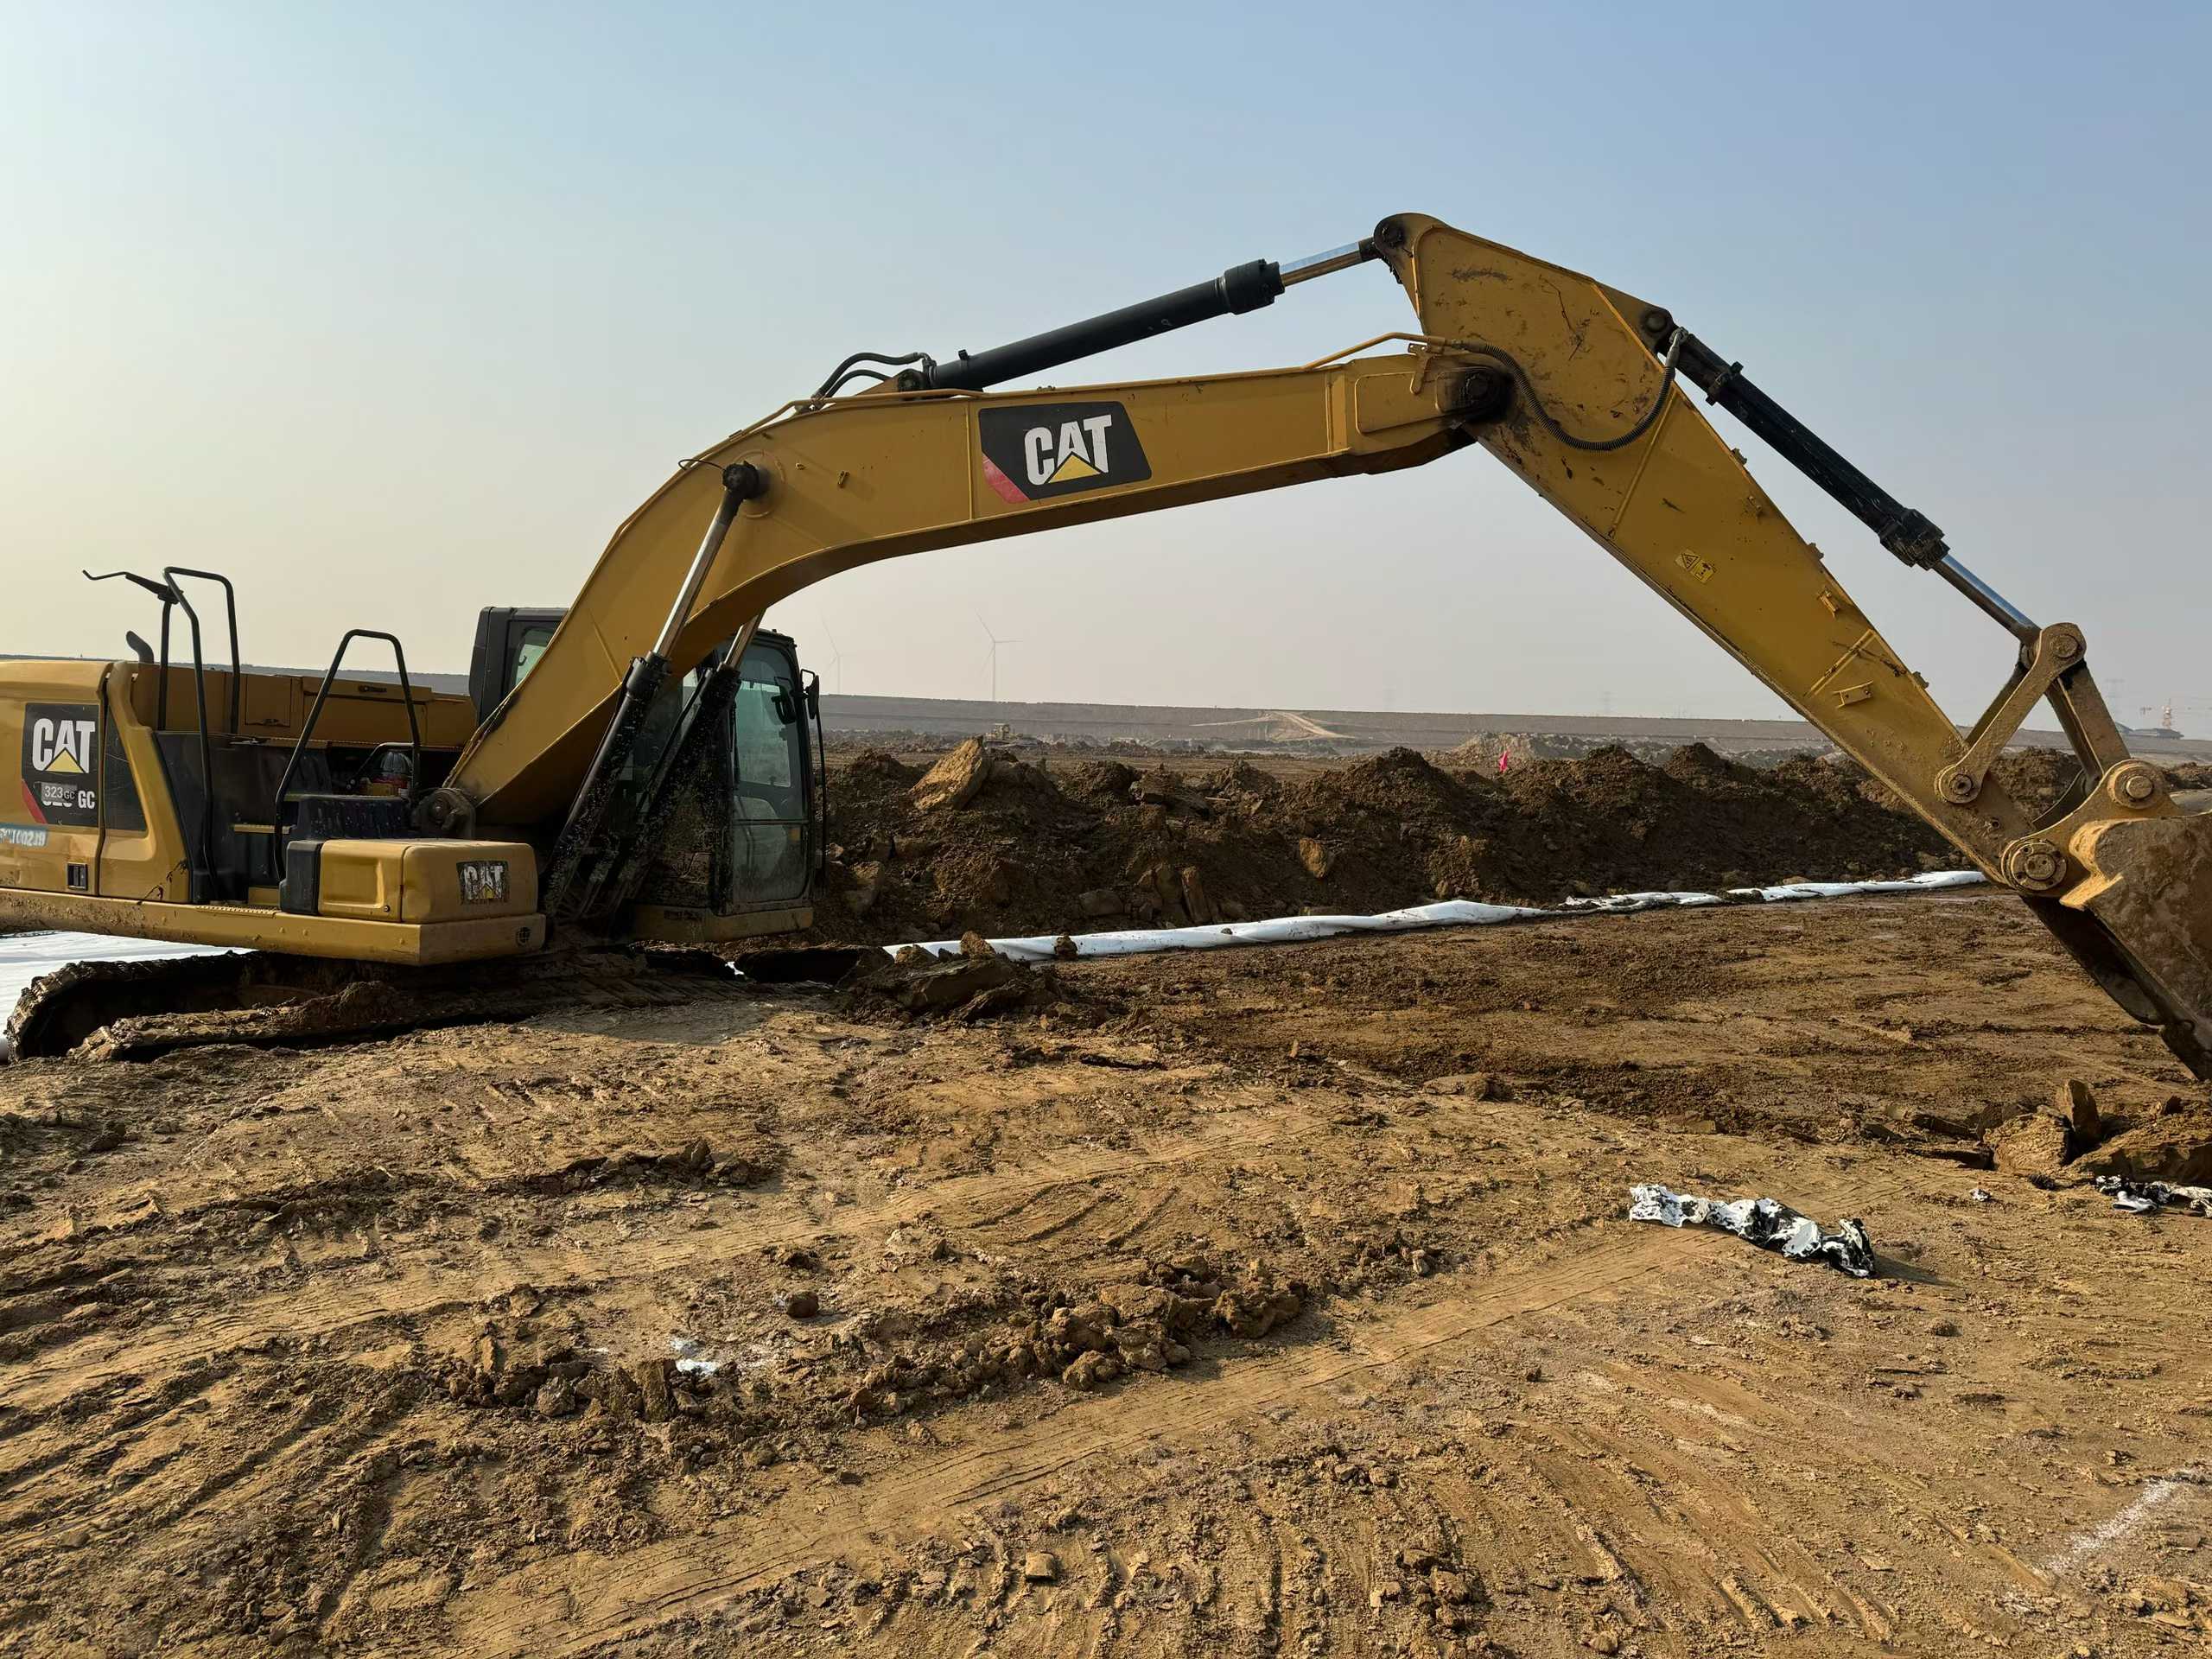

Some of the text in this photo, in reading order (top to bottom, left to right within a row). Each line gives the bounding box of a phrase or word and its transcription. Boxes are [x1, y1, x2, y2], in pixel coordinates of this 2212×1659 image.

[1024, 414, 1113, 486] CAT
[32, 717, 96, 774] CAT
[78, 790, 96, 809] GC
